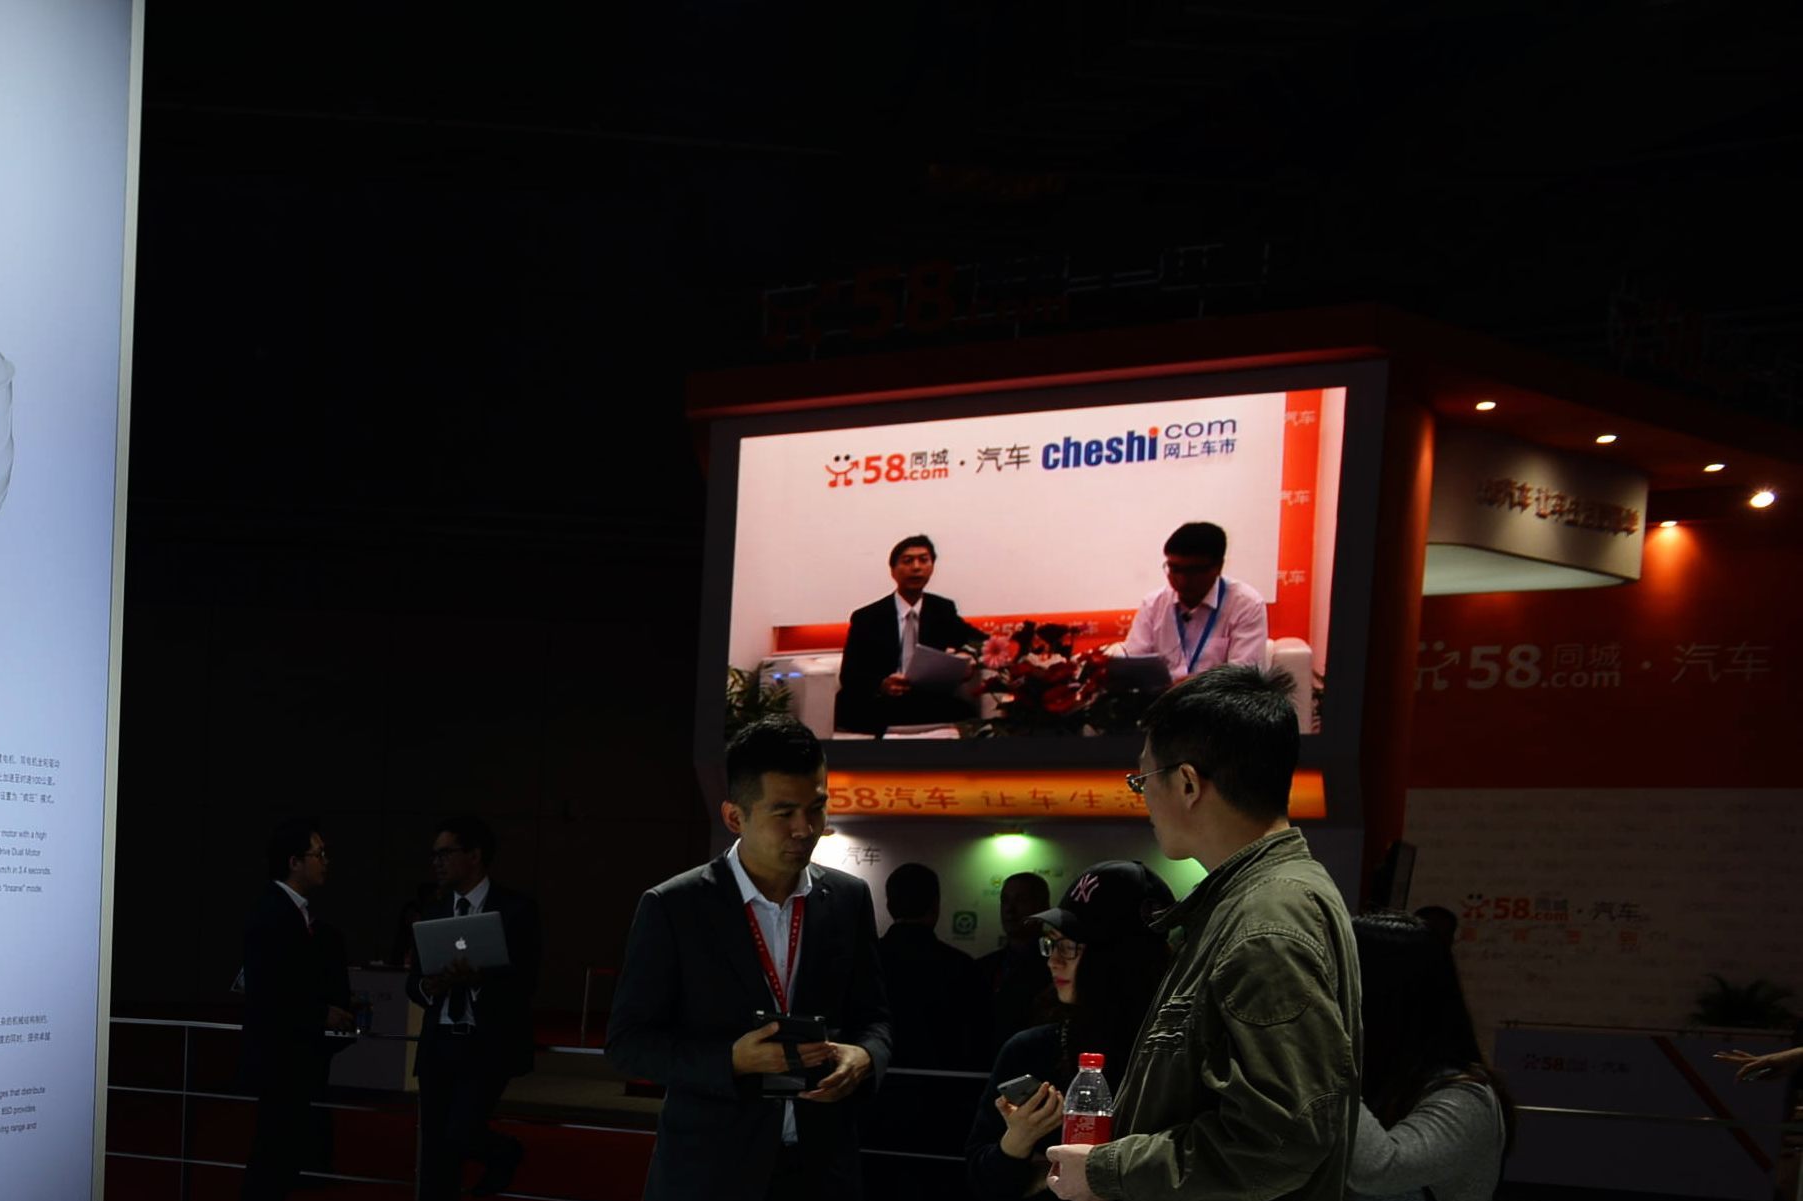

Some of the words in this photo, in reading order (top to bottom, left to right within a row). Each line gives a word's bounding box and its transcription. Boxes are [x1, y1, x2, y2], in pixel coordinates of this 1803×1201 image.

[976, 444, 1031, 473] 汽车
[1041, 426, 1160, 471] cheshi
[1163, 438, 1236, 460] 网上车市
[1671, 640, 1774, 684] 汽车
